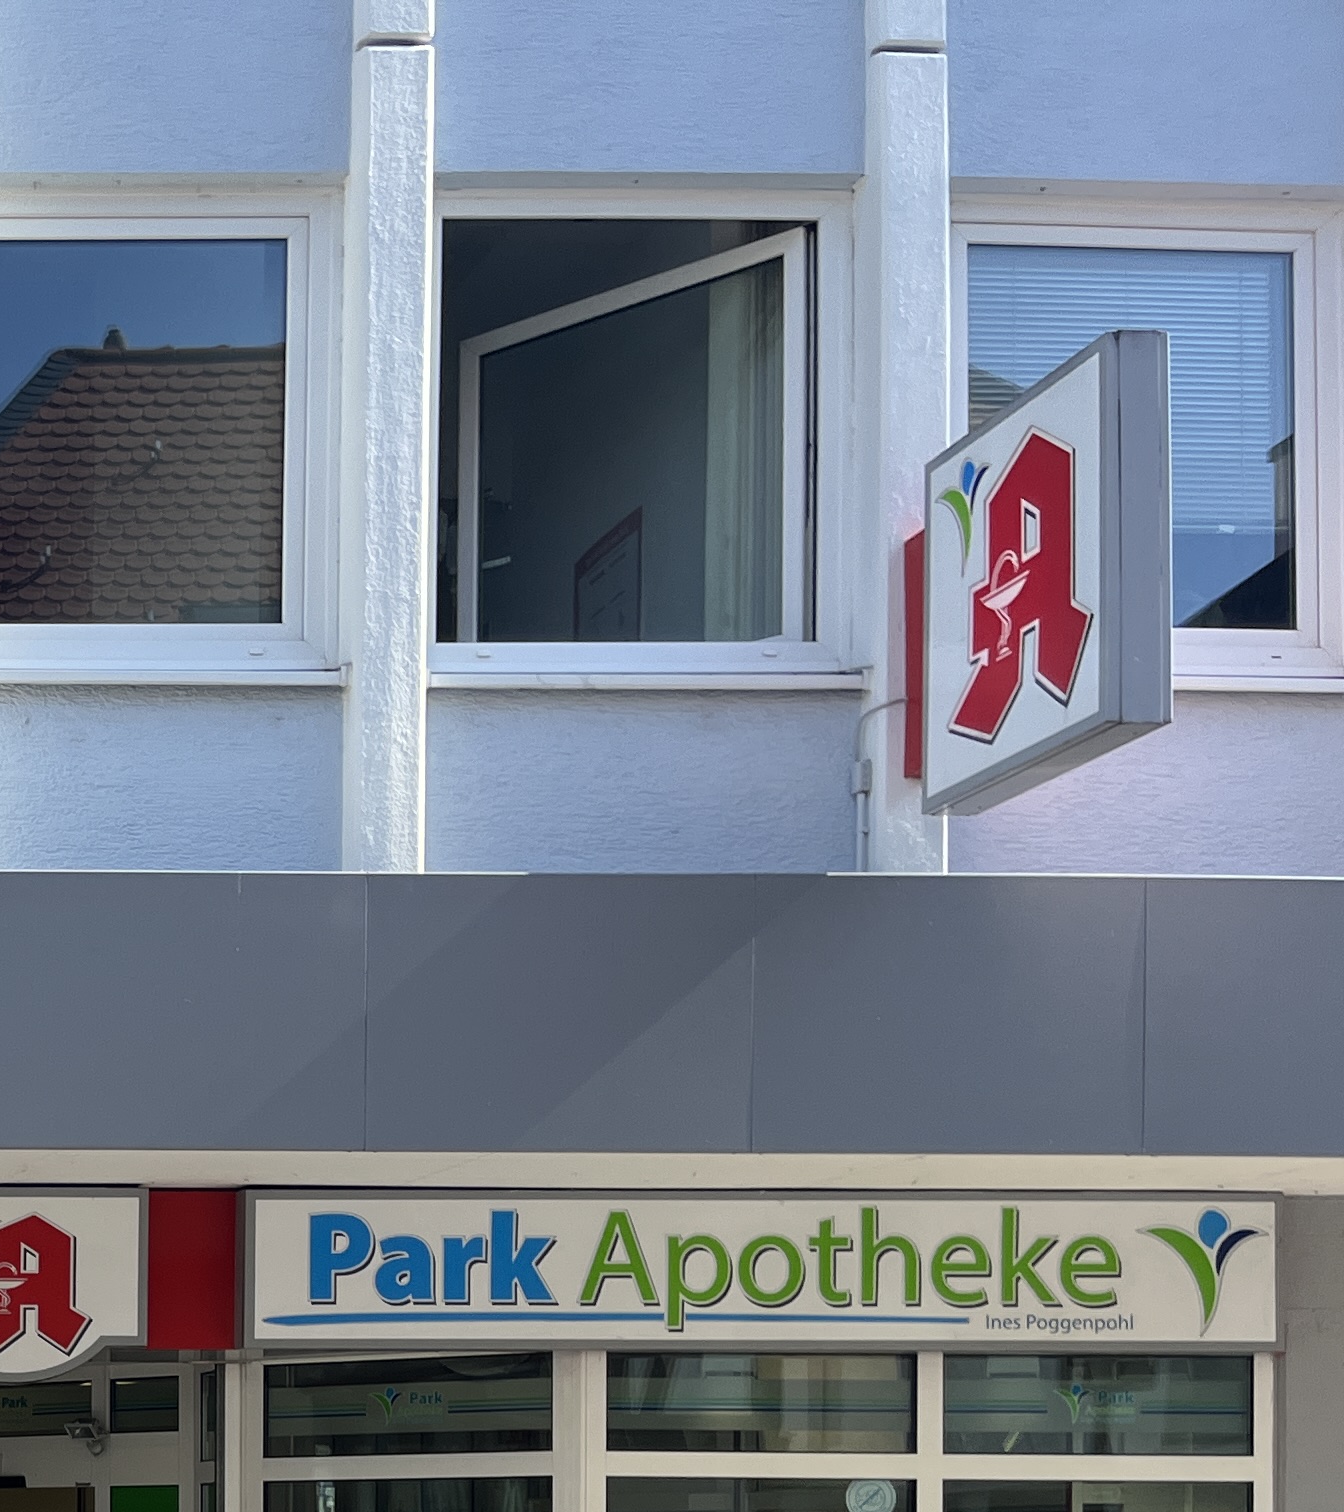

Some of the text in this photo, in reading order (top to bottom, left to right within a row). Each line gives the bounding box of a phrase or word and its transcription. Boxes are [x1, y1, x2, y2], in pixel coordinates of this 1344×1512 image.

[309, 1206, 1123, 1332] Park Apotheke
[985, 1314, 1134, 1336] Ines Poggenpohl
[2, 1396, 29, 1408] Park
[409, 1391, 442, 1404] Park
[1098, 1390, 1134, 1404] Park
